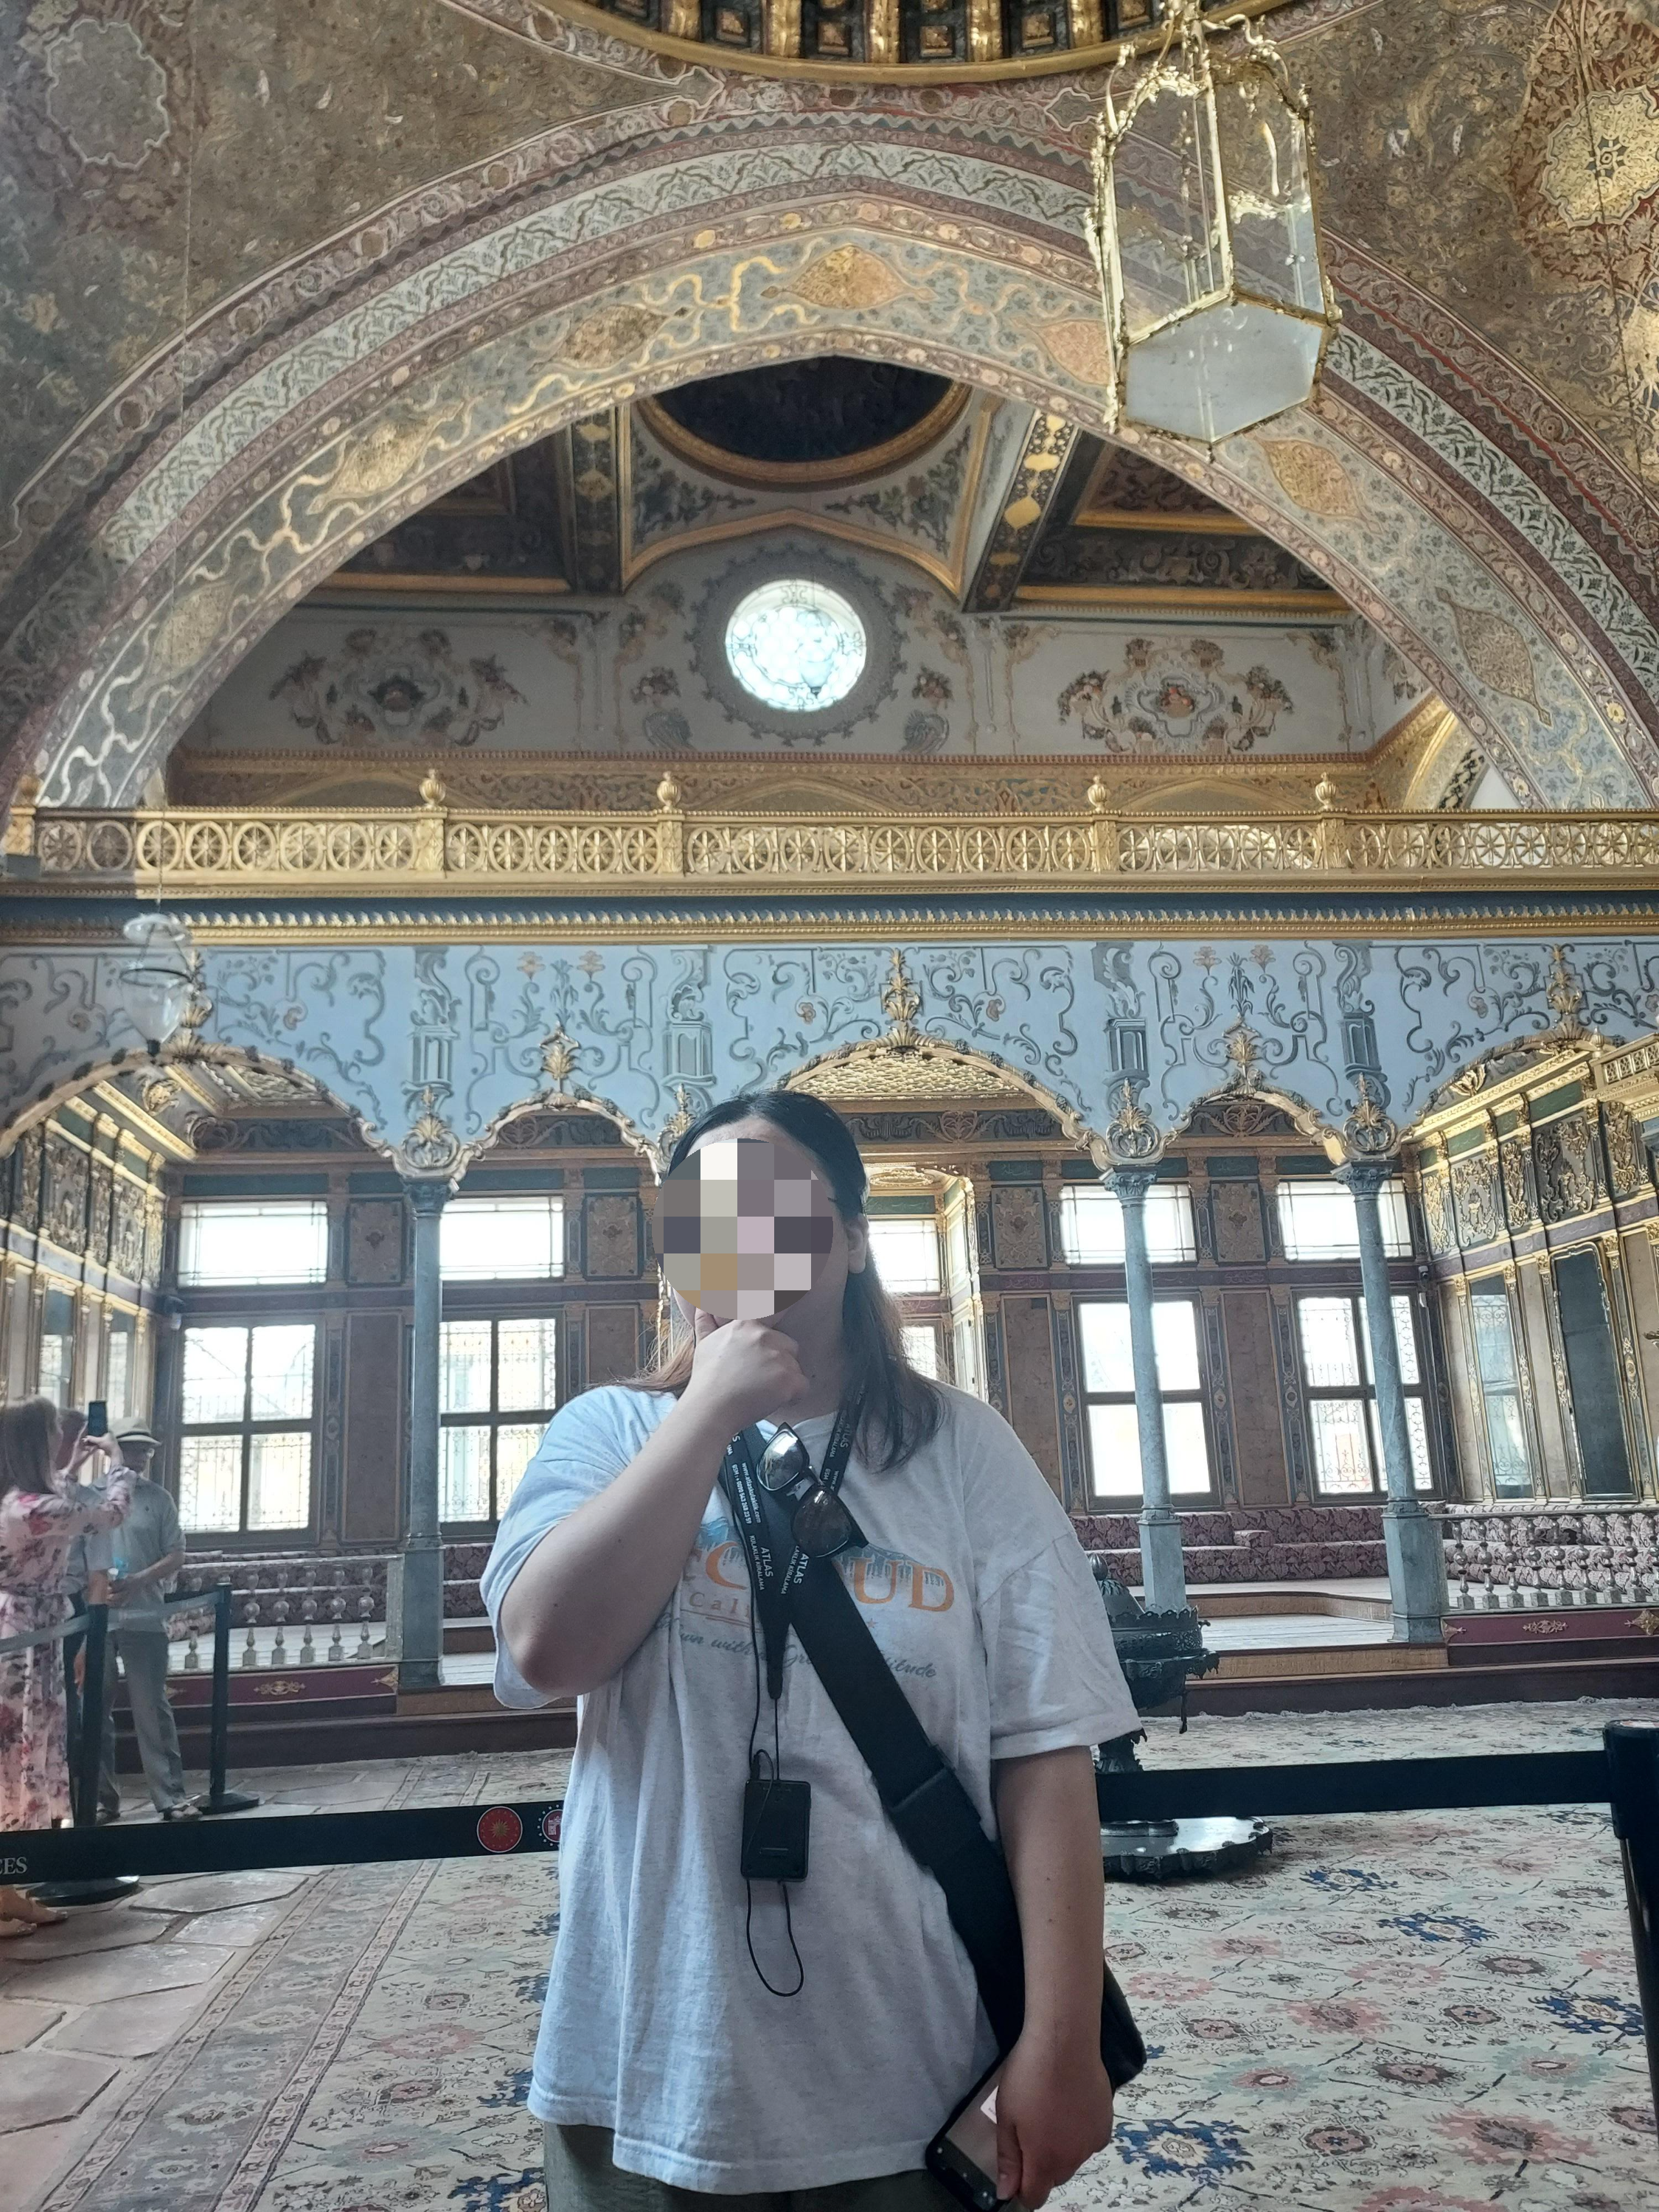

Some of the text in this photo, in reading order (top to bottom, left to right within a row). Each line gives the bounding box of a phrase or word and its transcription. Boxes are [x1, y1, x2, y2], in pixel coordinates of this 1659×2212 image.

[749, 1535, 760, 1561] KULAKLIK
[760, 1547, 773, 1577] ATLAS
[790, 1545, 799, 1565] LAKLIK
[793, 1553, 810, 1584] ATLAS
